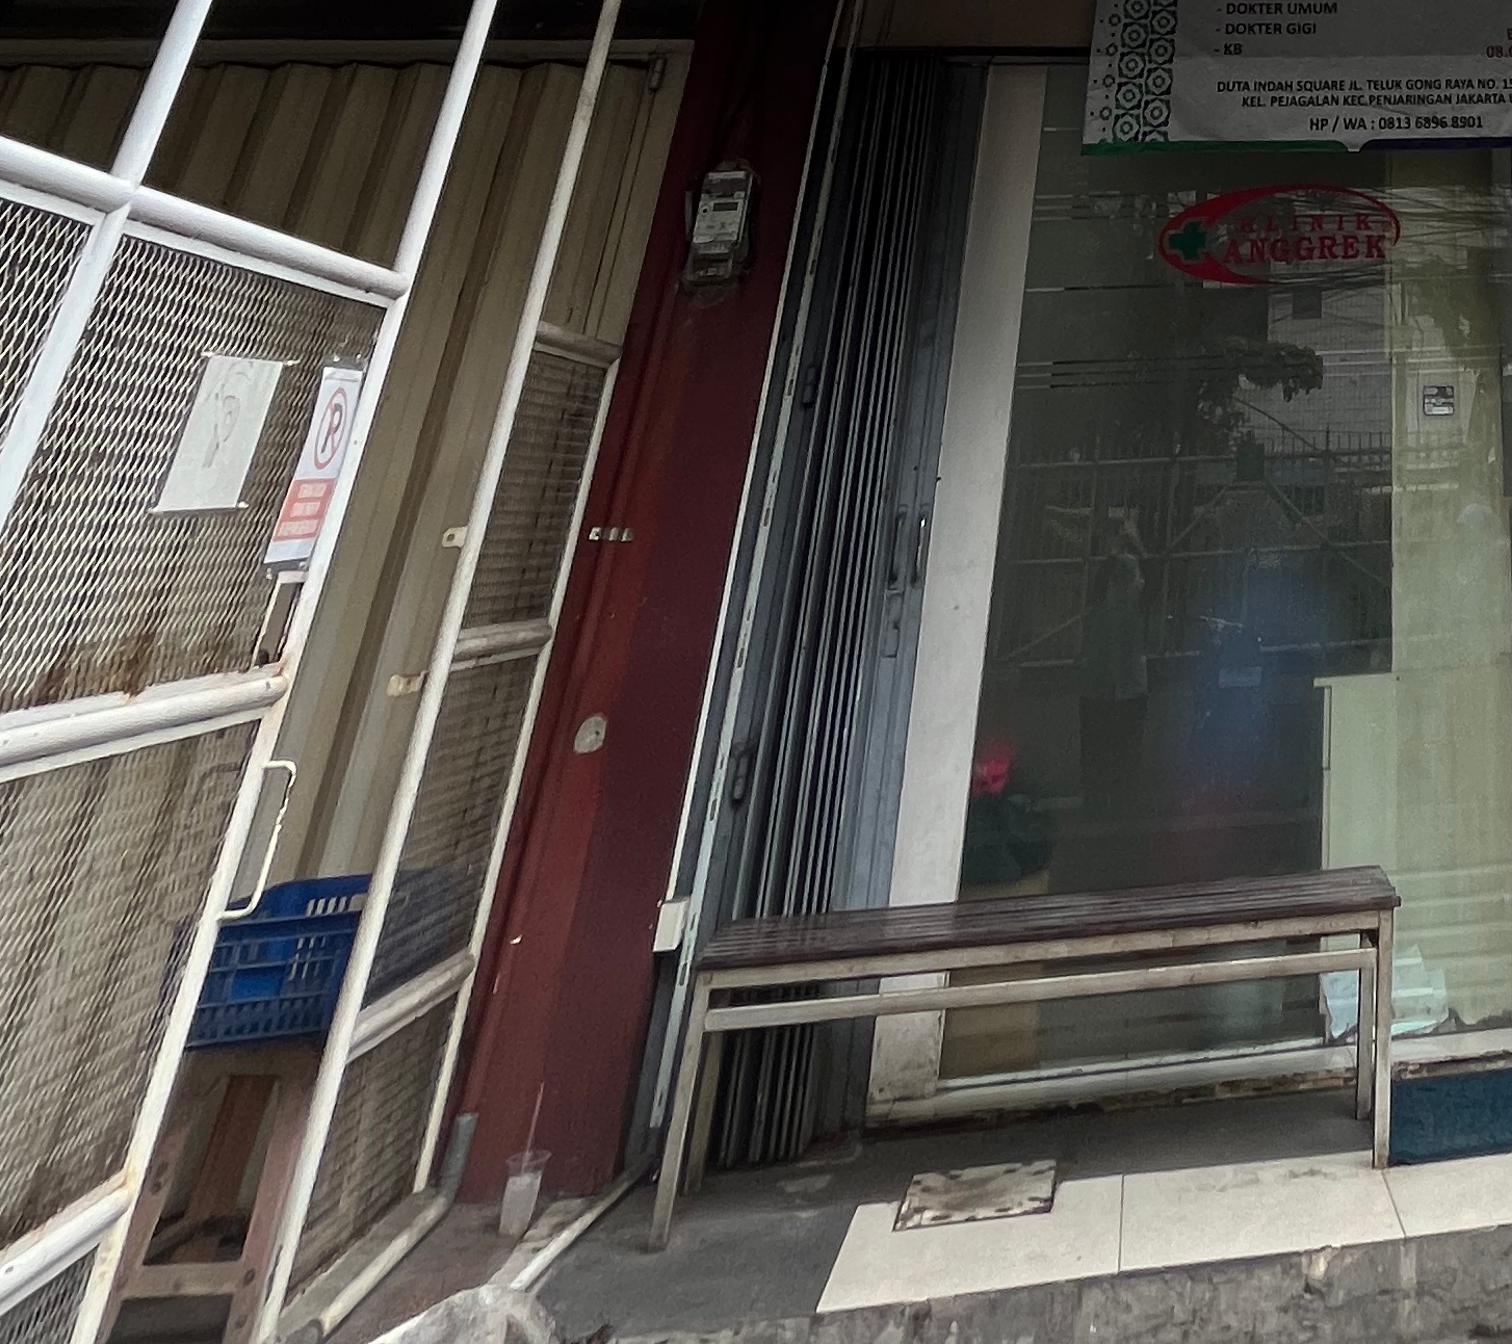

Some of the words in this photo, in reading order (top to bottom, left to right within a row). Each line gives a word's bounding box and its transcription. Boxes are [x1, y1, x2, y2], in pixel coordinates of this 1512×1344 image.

[1226, 2, 1283, 14] DOKTER
[1287, 2, 1338, 14] UMUM
[1225, 23, 1282, 35] DOKTER
[1286, 23, 1317, 34] GIGI
[1223, 43, 1243, 55] KB
[1216, 81, 1250, 93] DUTA
[1253, 81, 1293, 92] INDAH
[1296, 80, 1345, 93] SQUARE
[1348, 80, 1363, 92] JL.
[1366, 79, 1402, 91] TELUK
[1405, 79, 1442, 91] GONG
[1445, 78, 1474, 90] RAYA
[1477, 78, 1496, 90] NO.
[1241, 96, 1266, 107] KEL.
[1270, 95, 1339, 107] PEJAGALAN
[1456, 93, 1506, 105] JAKARTA
[1309, 118, 1328, 131] HP
[1343, 118, 1367, 131] WA
[1378, 117, 1411, 130] 0813
[1415, 116, 1448, 129] 6896
[1241, 214, 1372, 234] KLINIK
[1224, 234, 1386, 262] ANGGREK
